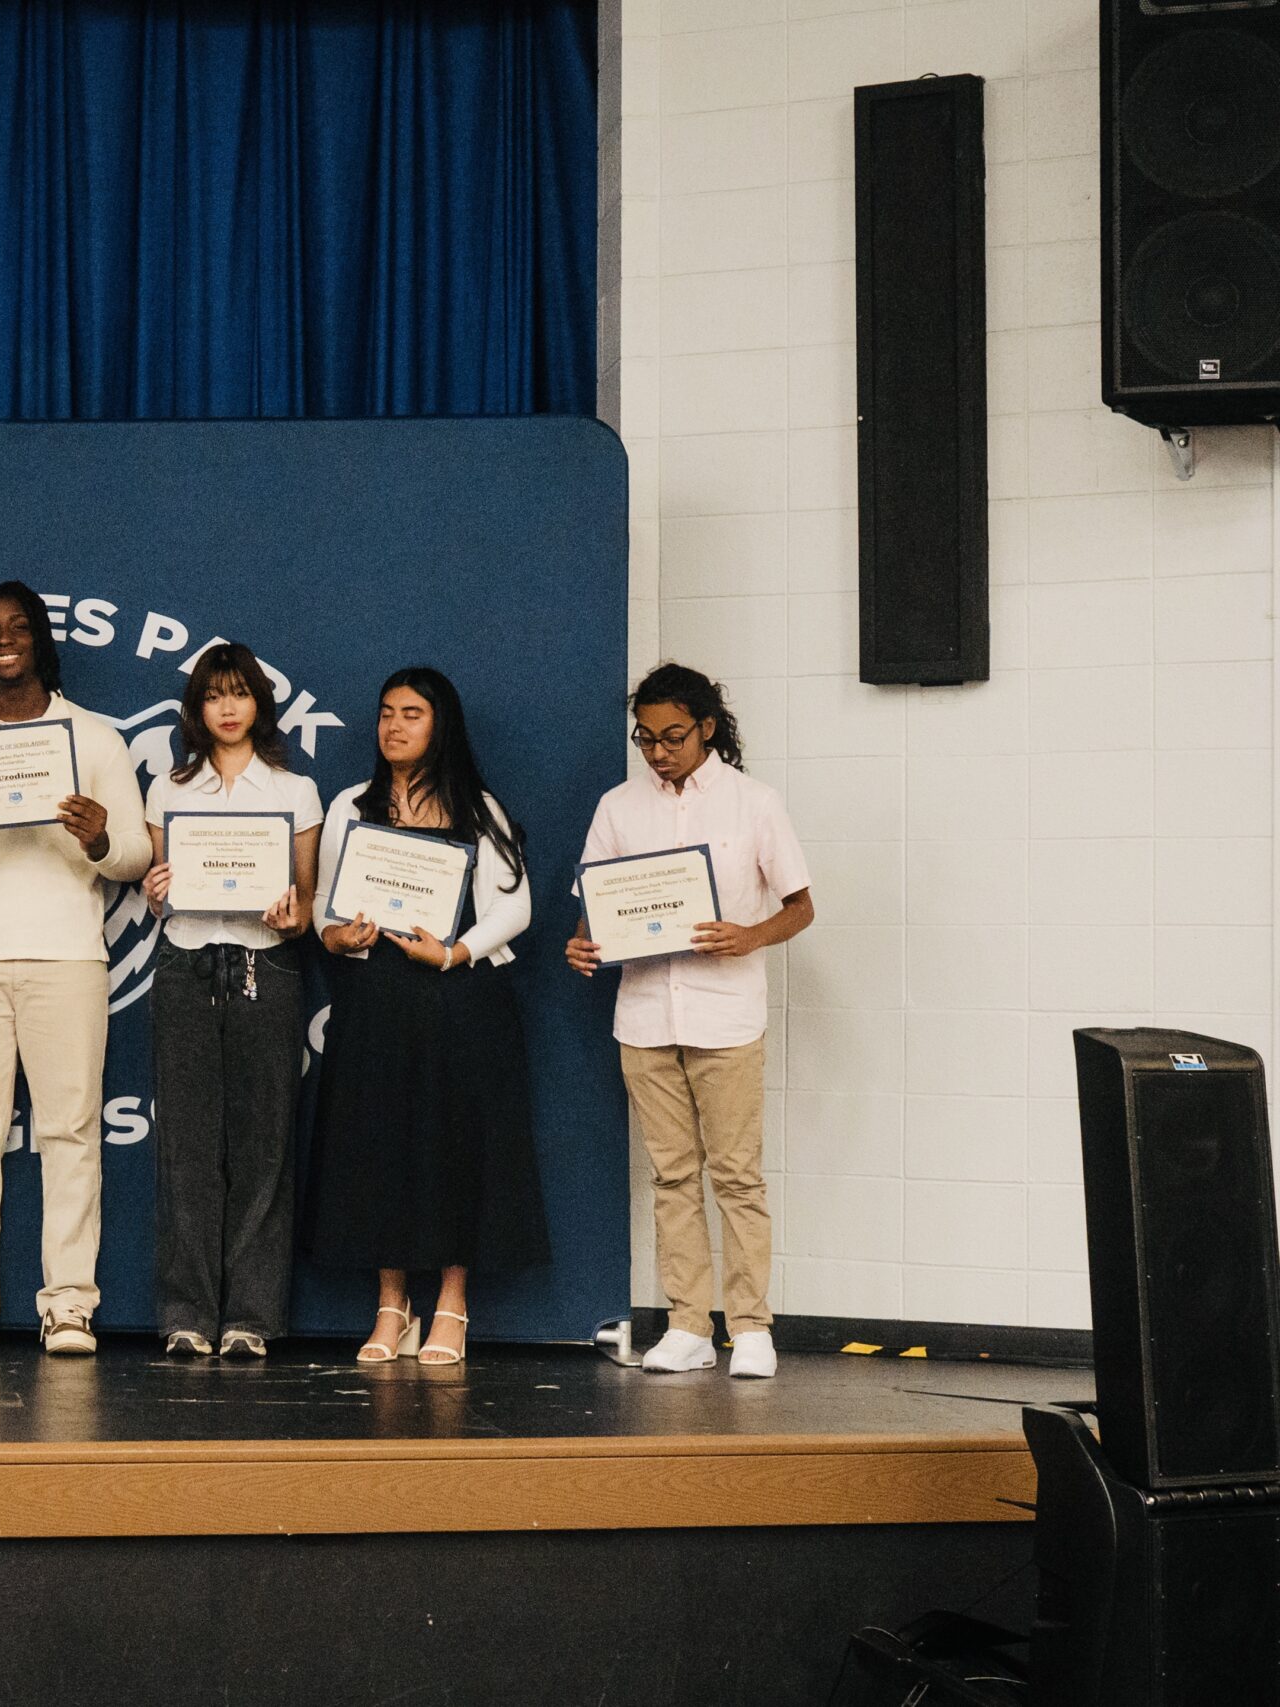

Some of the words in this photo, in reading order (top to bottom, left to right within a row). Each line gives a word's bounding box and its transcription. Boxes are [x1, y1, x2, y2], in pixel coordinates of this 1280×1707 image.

[365, 875, 400, 887] Genesis
[402, 882, 434, 895] Duarte
[617, 906, 648, 916] Eratzy
[651, 901, 684, 910] Ortega
